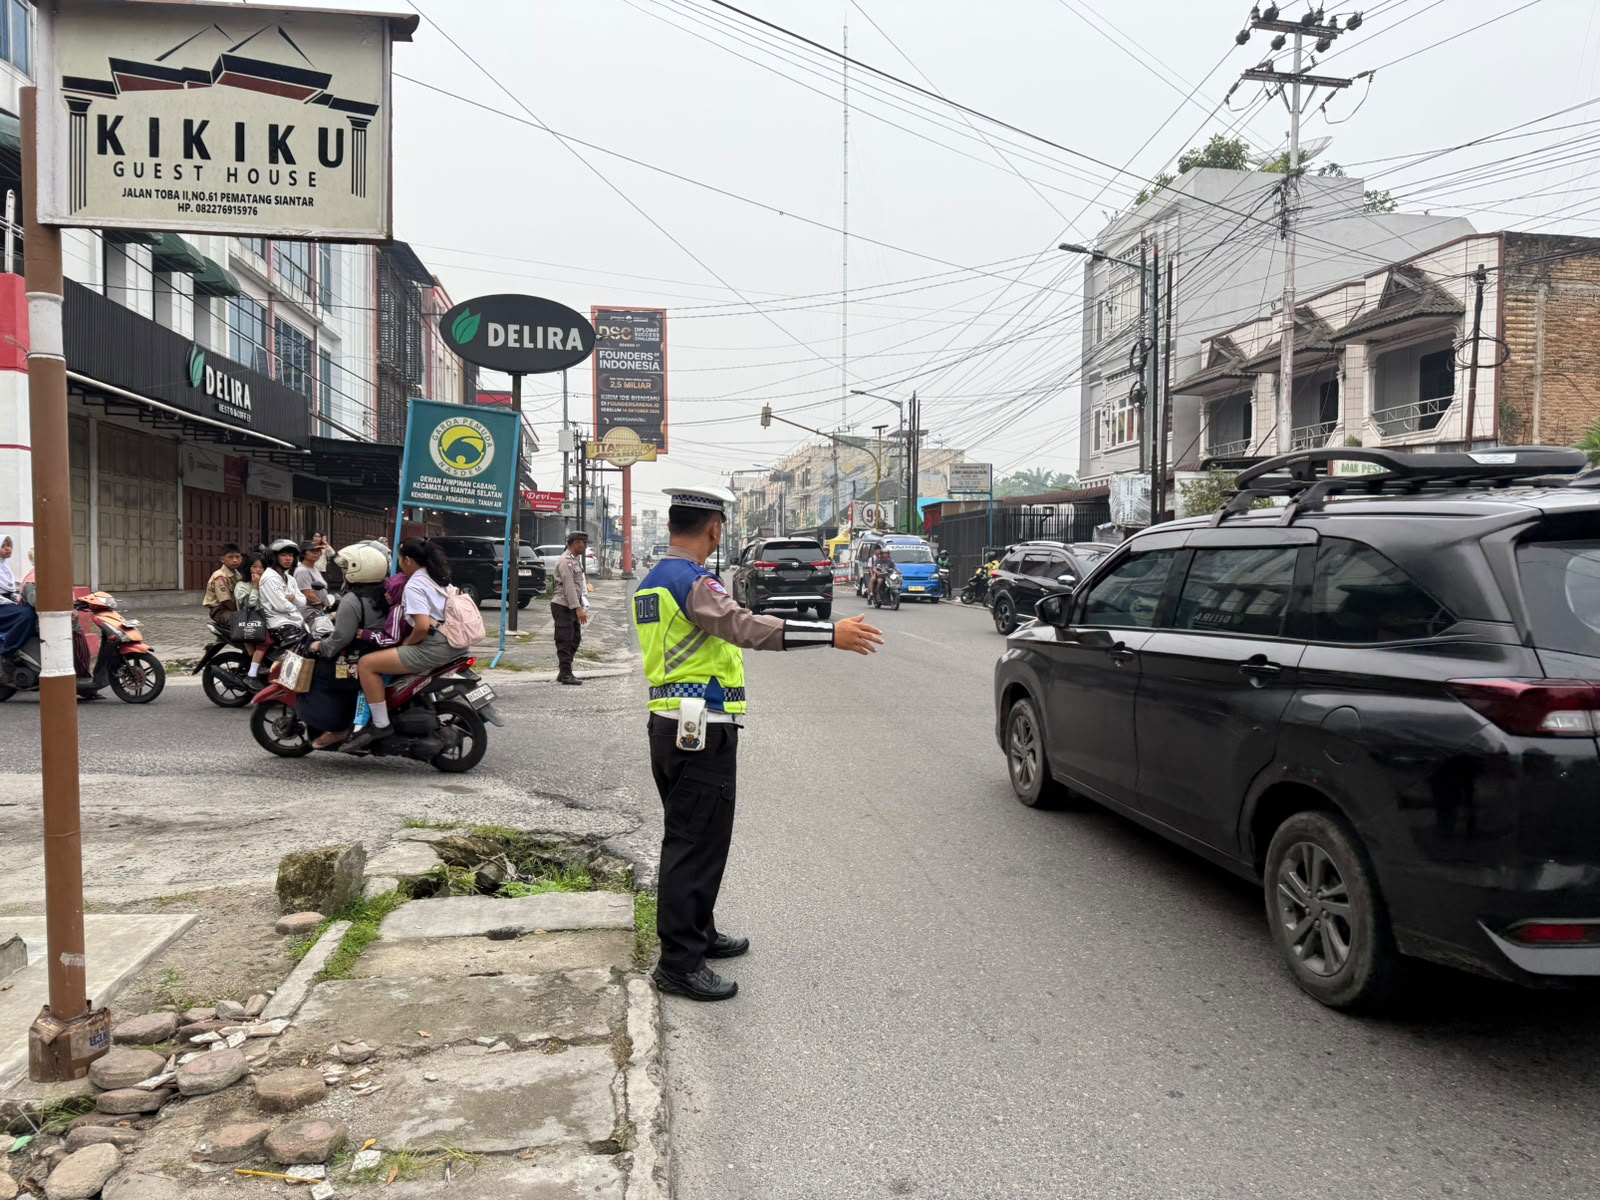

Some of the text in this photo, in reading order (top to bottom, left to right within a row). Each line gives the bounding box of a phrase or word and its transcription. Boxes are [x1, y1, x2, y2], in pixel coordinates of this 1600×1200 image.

[97, 114, 344, 168] KIKIKU
[113, 161, 317, 188] GUEST HOUSE
[122, 187, 152, 200] JALAN
[154, 189, 180, 201] TOBA
[220, 192, 272, 206] PEMATANG
[274, 195, 314, 207] SIANTAR
[177, 203, 258, 216] HP. 082276915976
[487, 322, 583, 351] DELIRA
[599, 326, 632, 340] DSC
[600, 351, 653, 360] FOUNDERS
[600, 360, 660, 370] INDONESIA
[205, 364, 251, 411] DELIRA
[624, 381, 651, 389] MILIAR
[432, 418, 492, 448] GARDA PEMUDA
[438, 461, 482, 477] NASDEM
[413, 482, 502, 498] KECAMATAN SIANTAR SELATAN
[420, 475, 497, 490] DEWAN PIMPINAN CABANG
[411, 492, 442, 501] KEHORMATAN
[445, 495, 475, 505] PENGABDIAN
[478, 499, 493, 507] TANAH
[526, 491, 551, 500] Devi
